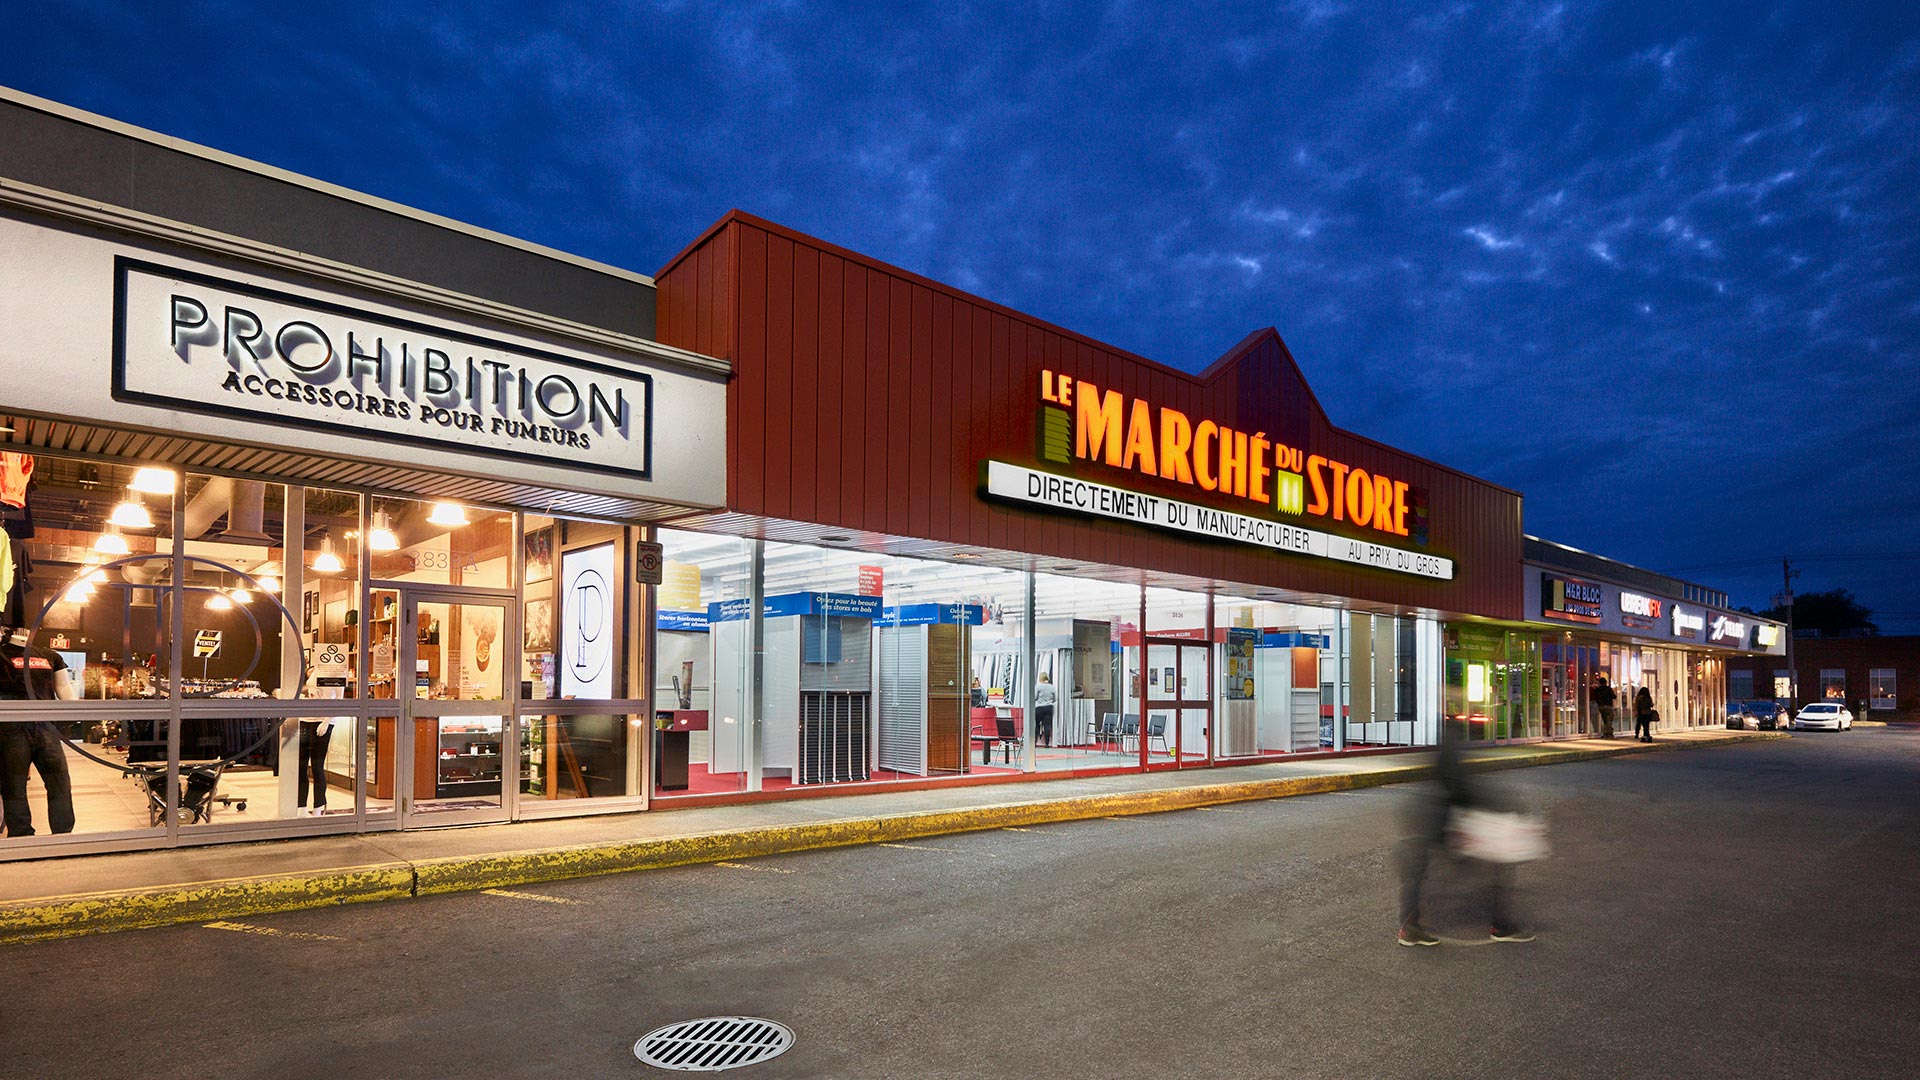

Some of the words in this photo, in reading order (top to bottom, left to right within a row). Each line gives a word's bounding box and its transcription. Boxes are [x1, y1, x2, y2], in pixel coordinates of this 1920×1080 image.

[170, 293, 623, 428] PROHIBITION
[1041, 369, 1072, 406] LE
[222, 370, 411, 419] ACCESSOIRES
[420, 405, 485, 433] POUR
[492, 417, 592, 449] FUMEURS
[1076, 380, 1271, 504] MARCHÉ
[1275, 442, 1304, 474] DU
[1306, 455, 1410, 537] STORE
[1027, 473, 1159, 521] DIRECTEMENT
[1167, 503, 1189, 528] DU
[1197, 509, 1311, 551] MANUFACTURIER
[1348, 541, 1363, 560] AU
[1368, 545, 1392, 566] PRIX
[1397, 551, 1411, 570] DU
[1416, 555, 1441, 576] GROS
[52, 639, 67, 648] EXIT
[833, 604, 850, 612] stores
